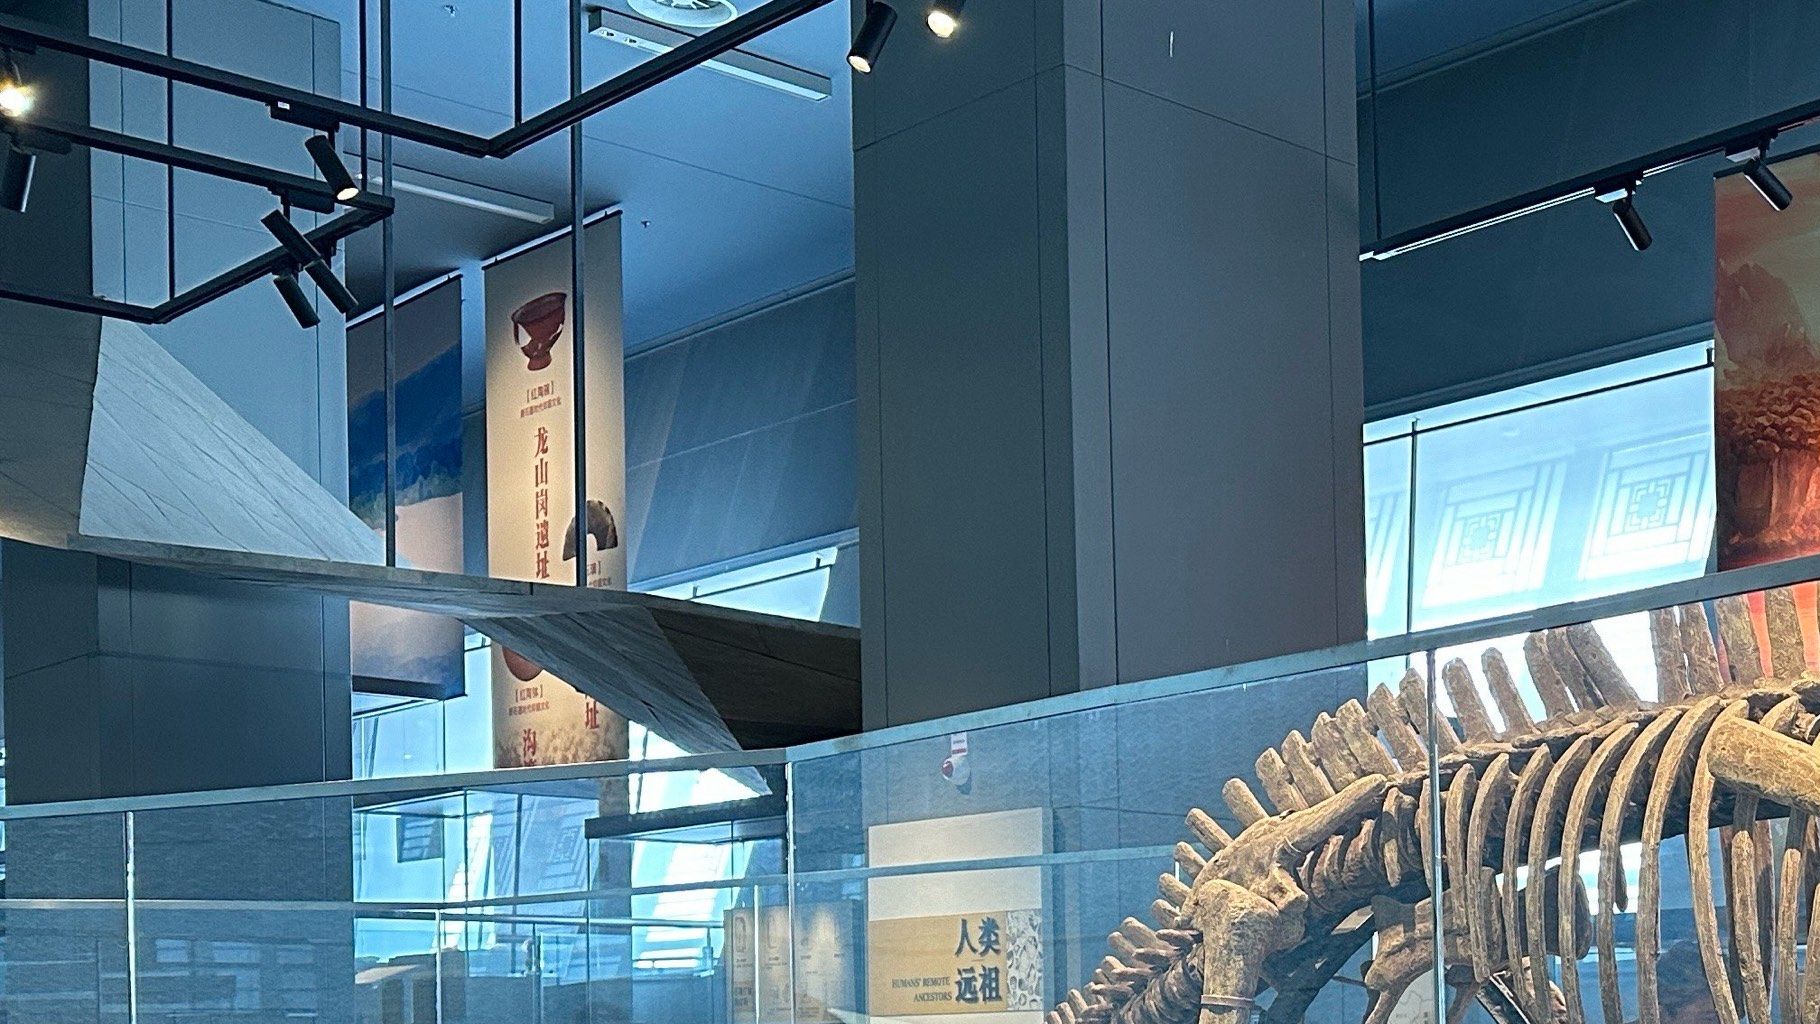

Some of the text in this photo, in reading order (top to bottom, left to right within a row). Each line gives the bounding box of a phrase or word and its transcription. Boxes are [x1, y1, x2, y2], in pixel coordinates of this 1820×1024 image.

[534, 426, 550, 579] 龙山岗遗址
[585, 695, 600, 729] 址
[955, 916, 1001, 957] 人类
[913, 991, 953, 1003] ANCESTORS
[922, 976, 950, 987] REMOTE
[955, 964, 1002, 1004] 远祖
